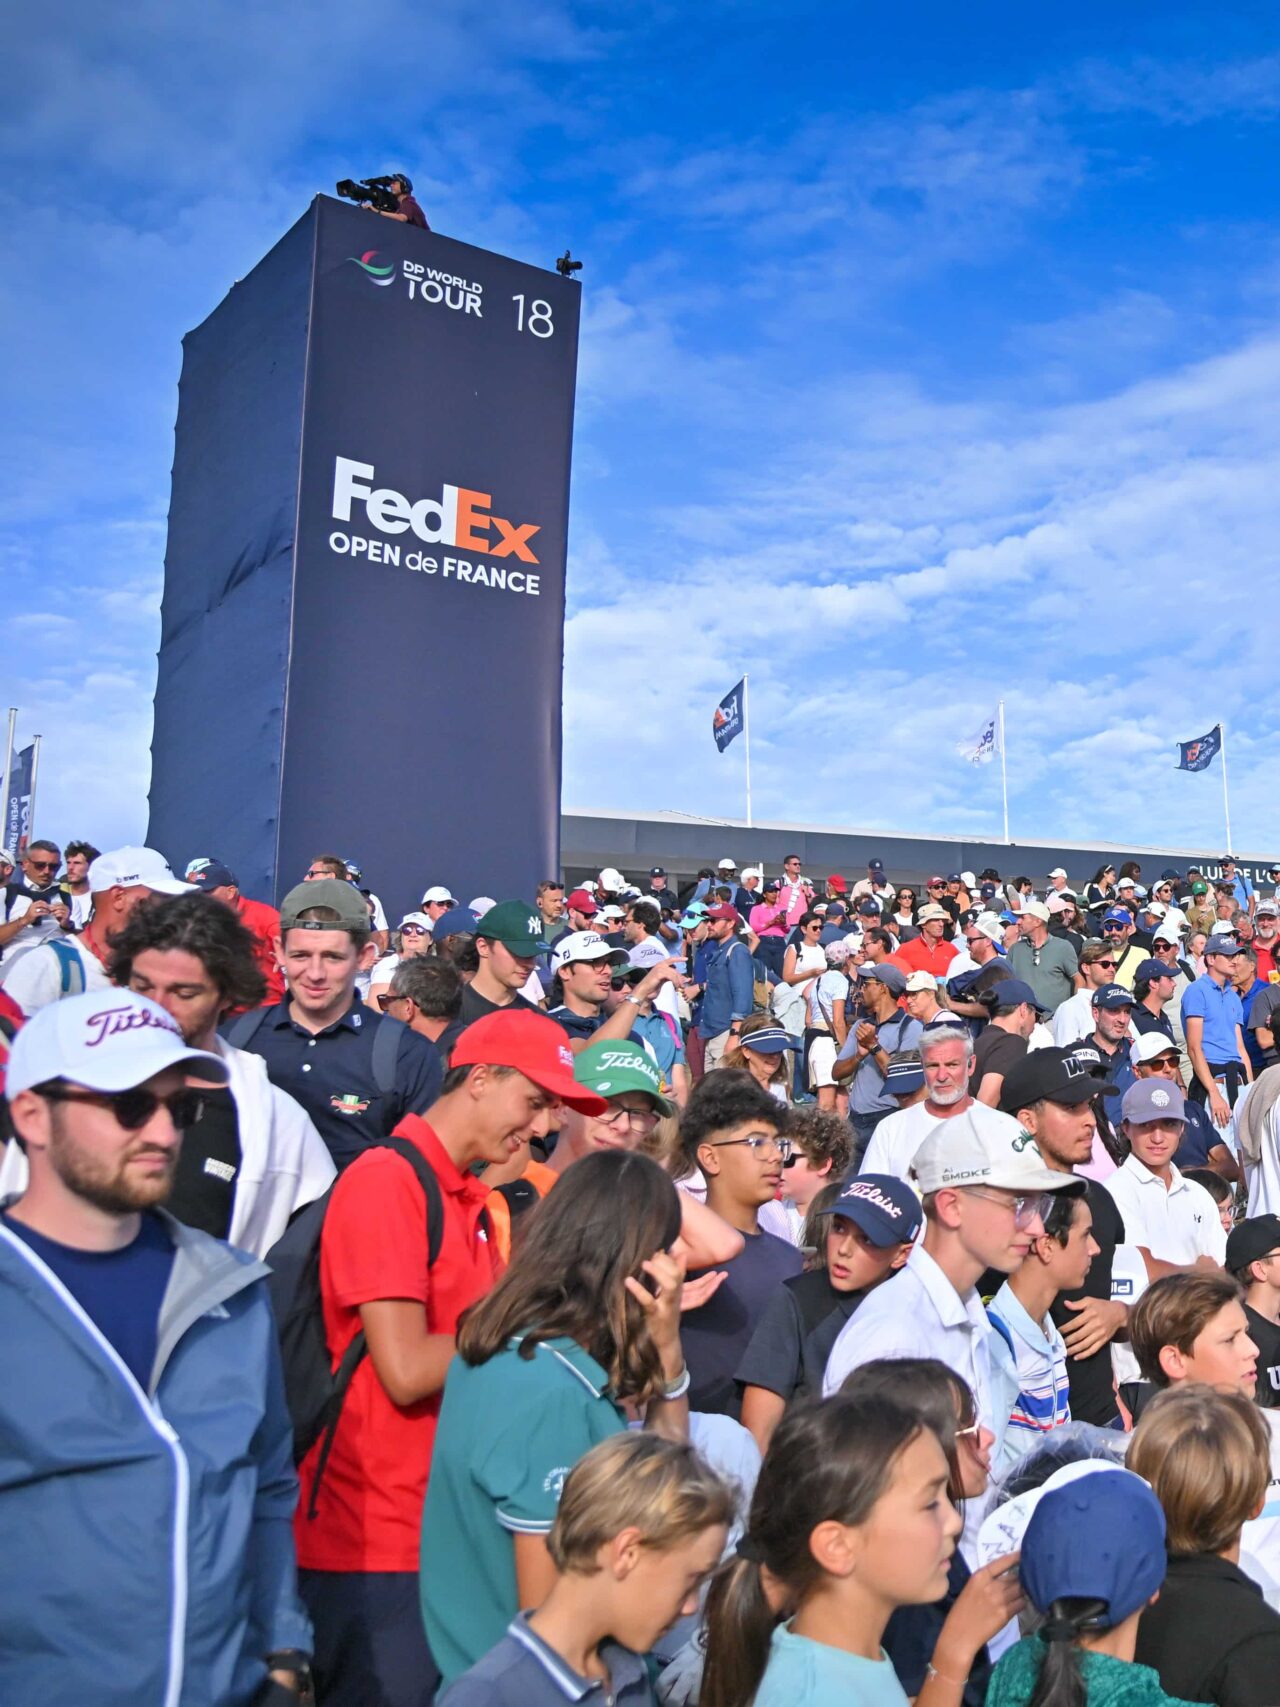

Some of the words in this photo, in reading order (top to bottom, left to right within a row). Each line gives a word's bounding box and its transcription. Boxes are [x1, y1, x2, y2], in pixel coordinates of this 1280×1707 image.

[403, 260, 425, 275] DP
[426, 269, 483, 294] WORLD
[403, 272, 483, 318] TOUR
[512, 294, 554, 338] 18
[332, 455, 541, 564] FedEx
[329, 531, 400, 567] OPEN
[405, 551, 438, 574] de
[442, 557, 540, 595] FRANCE
[10, 797, 19, 820] OPEN
[9, 832, 19, 859] FRAN
[528, 916, 541, 934] NY
[562, 949, 571, 960] FJ
[1063, 1057, 1085, 1078] W
[942, 1167, 991, 1182] SMOKE
[842, 1182, 902, 1219] Titleist
